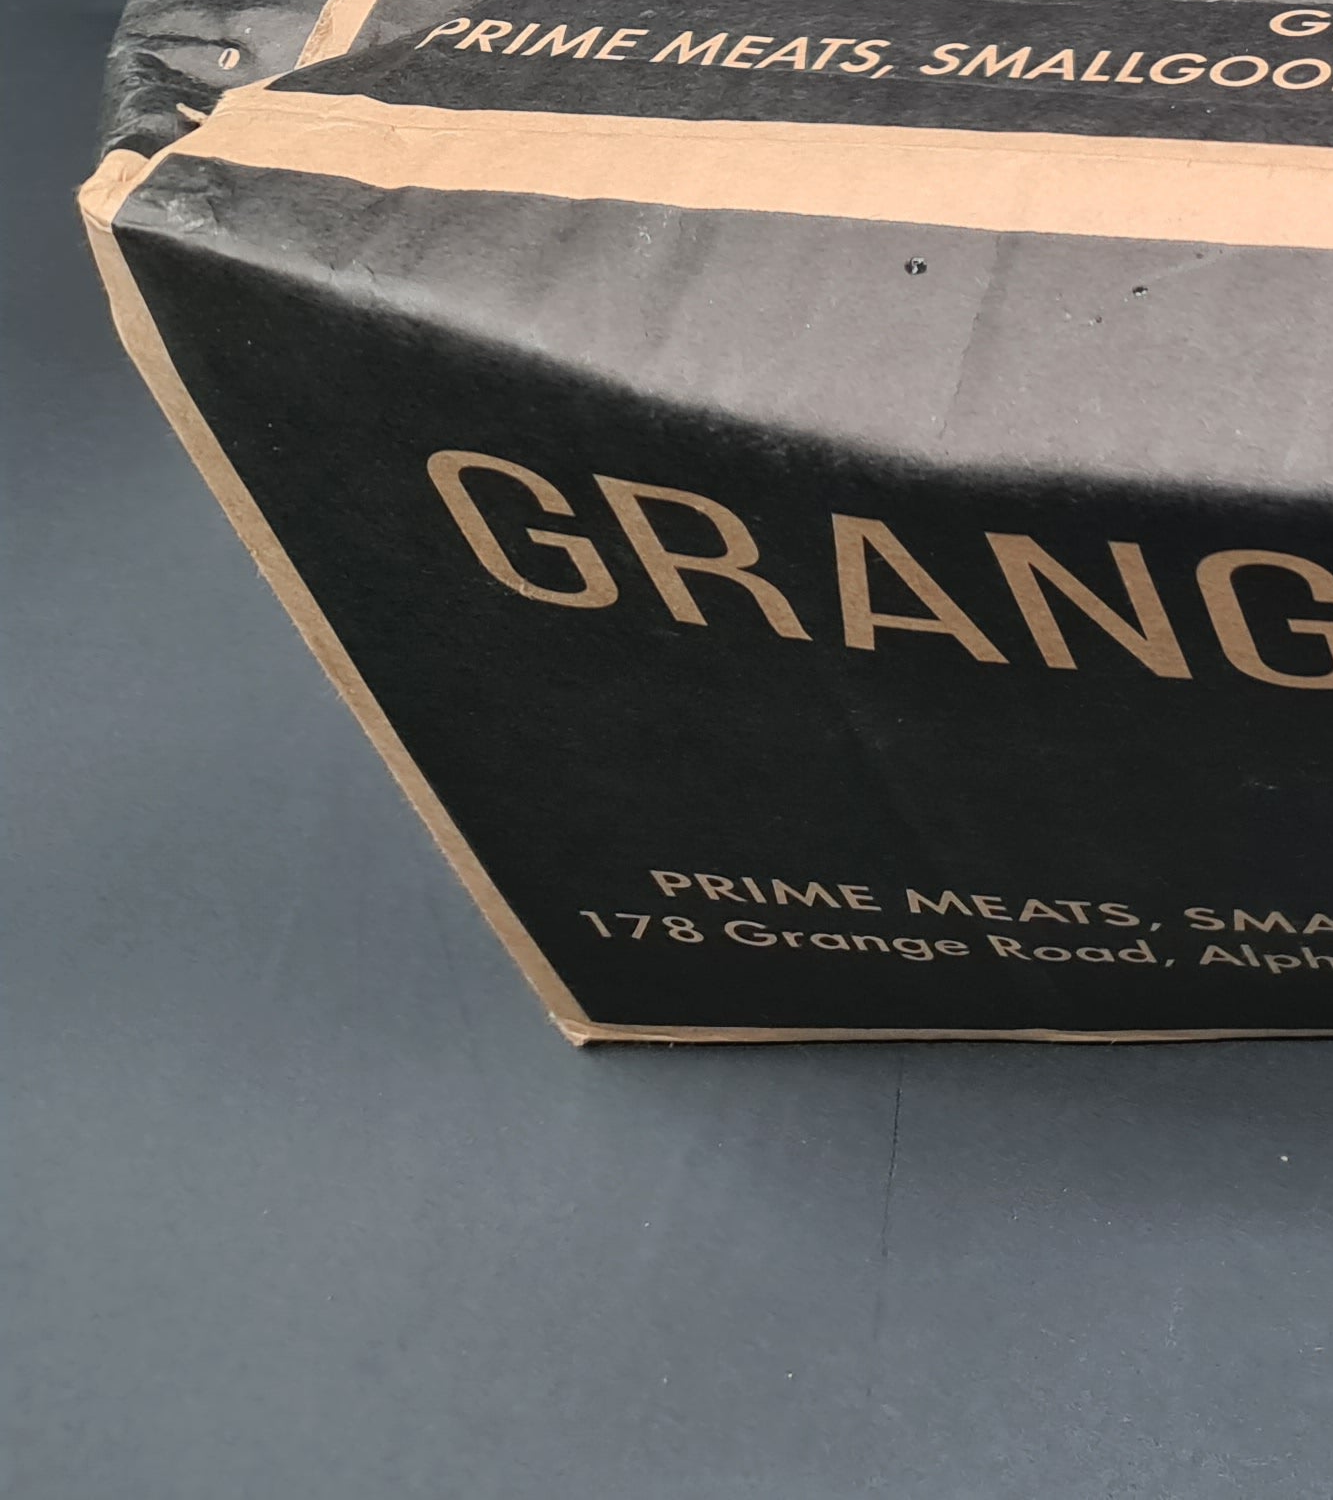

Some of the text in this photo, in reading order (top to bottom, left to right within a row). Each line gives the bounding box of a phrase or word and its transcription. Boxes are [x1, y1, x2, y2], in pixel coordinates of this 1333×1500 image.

[415, 15, 647, 62] PRIME
[650, 30, 893, 79] MEATS,
[647, 867, 885, 914] PRIME
[903, 886, 1164, 934] MEATS,
[577, 908, 707, 946] 178
[721, 917, 972, 964] Grange
[984, 932, 1177, 970] Road,
